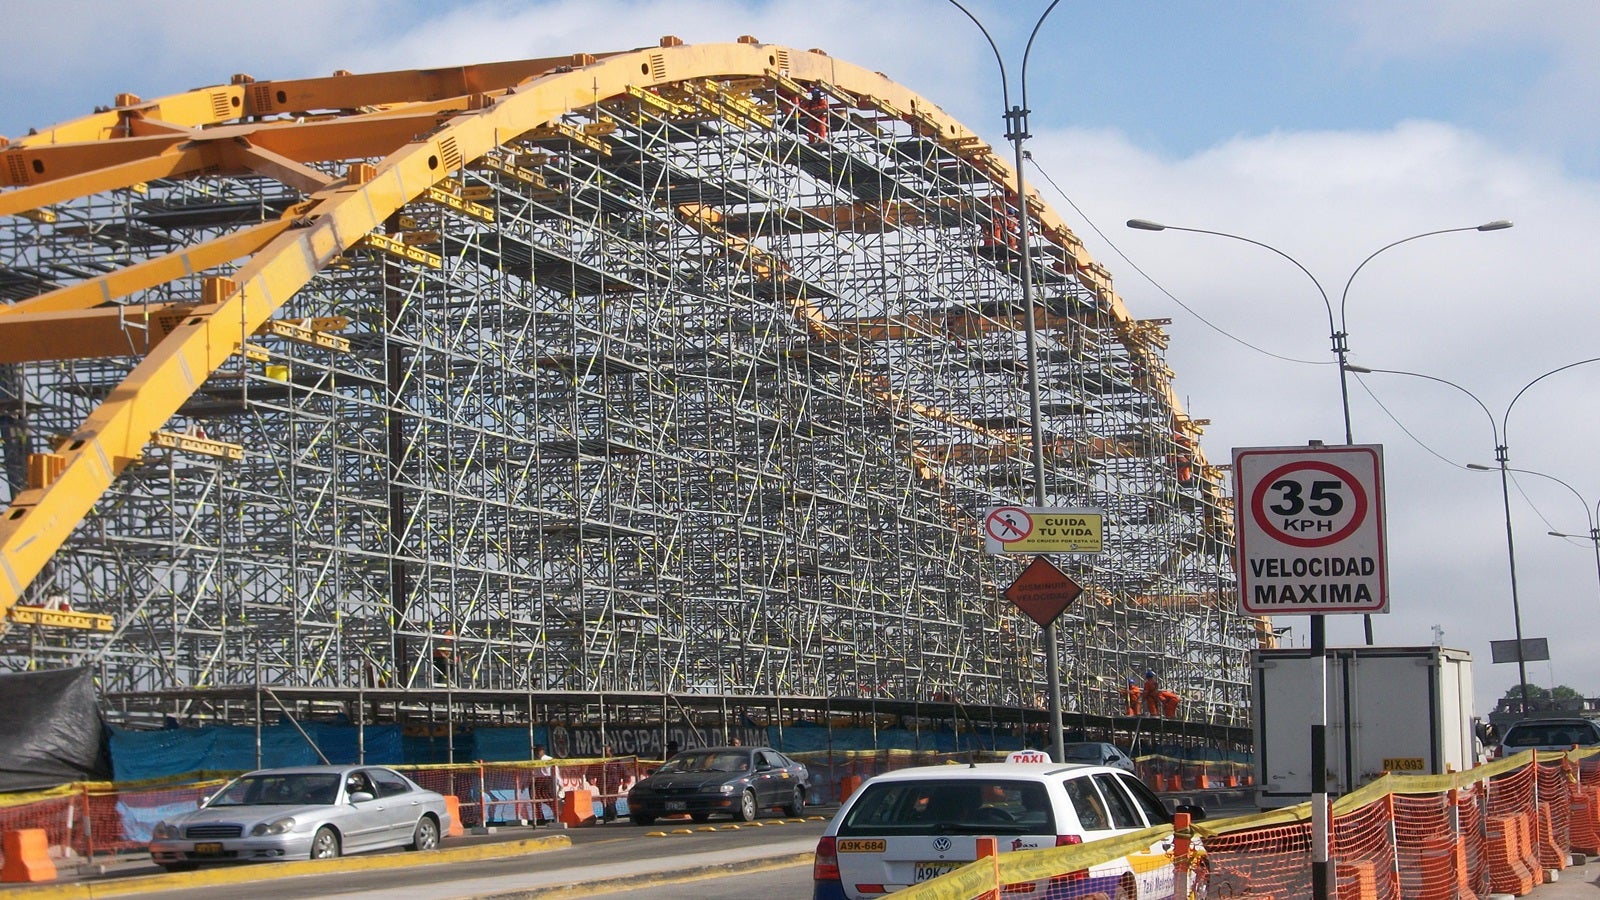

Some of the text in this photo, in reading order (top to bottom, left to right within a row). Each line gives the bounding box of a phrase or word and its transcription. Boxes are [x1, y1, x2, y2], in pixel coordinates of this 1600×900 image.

[1270, 480, 1343, 516] 35
[1045, 518, 1086, 526] CUIDA
[1284, 519, 1332, 532] KPH
[1039, 528, 1093, 536] TU VIDA
[1250, 557, 1375, 577] VELOCIDAD
[1018, 582, 1066, 591] DISMINUIR
[1255, 583, 1372, 604] MAXIMA
[1013, 754, 1044, 763] TAXI
[840, 842, 884, 850] A9K-684
[917, 867, 959, 881] A9K-
